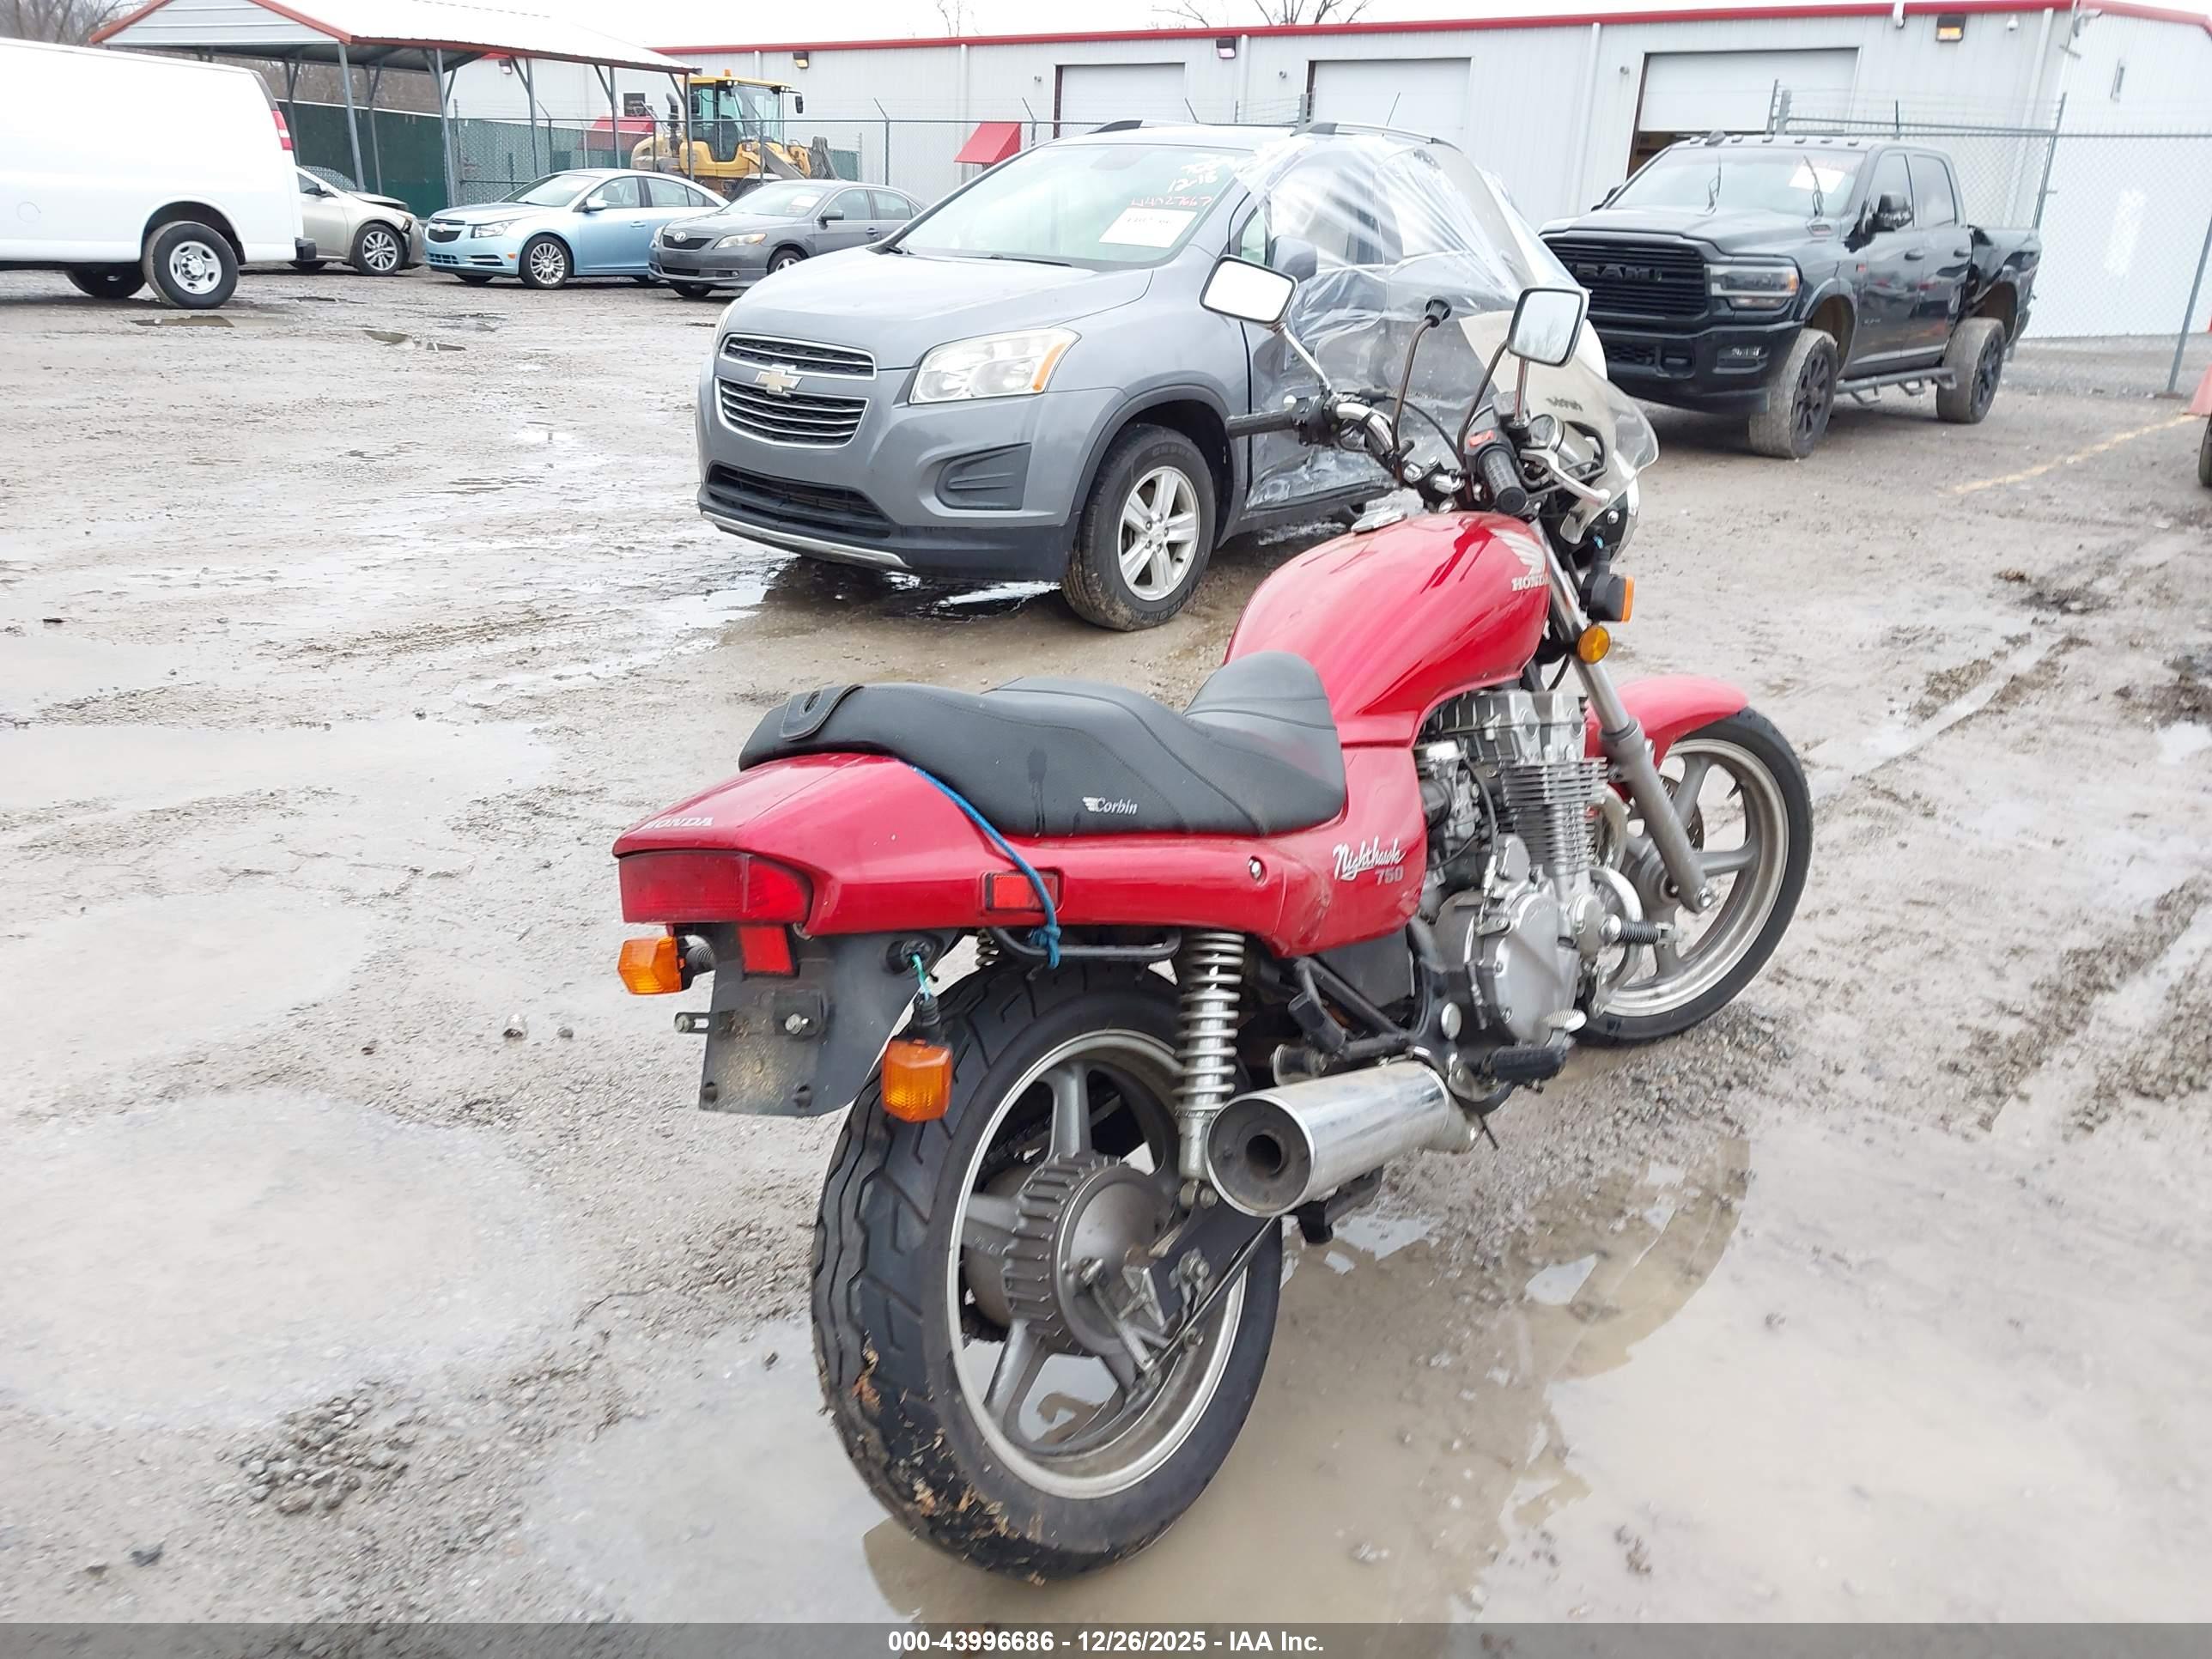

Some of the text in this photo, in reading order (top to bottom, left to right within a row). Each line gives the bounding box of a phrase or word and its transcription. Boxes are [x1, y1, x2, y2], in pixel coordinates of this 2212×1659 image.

[1576, 263, 1650, 282] RAM
[1094, 797, 1138, 815] Corbin
[1375, 865, 1404, 885] 750
